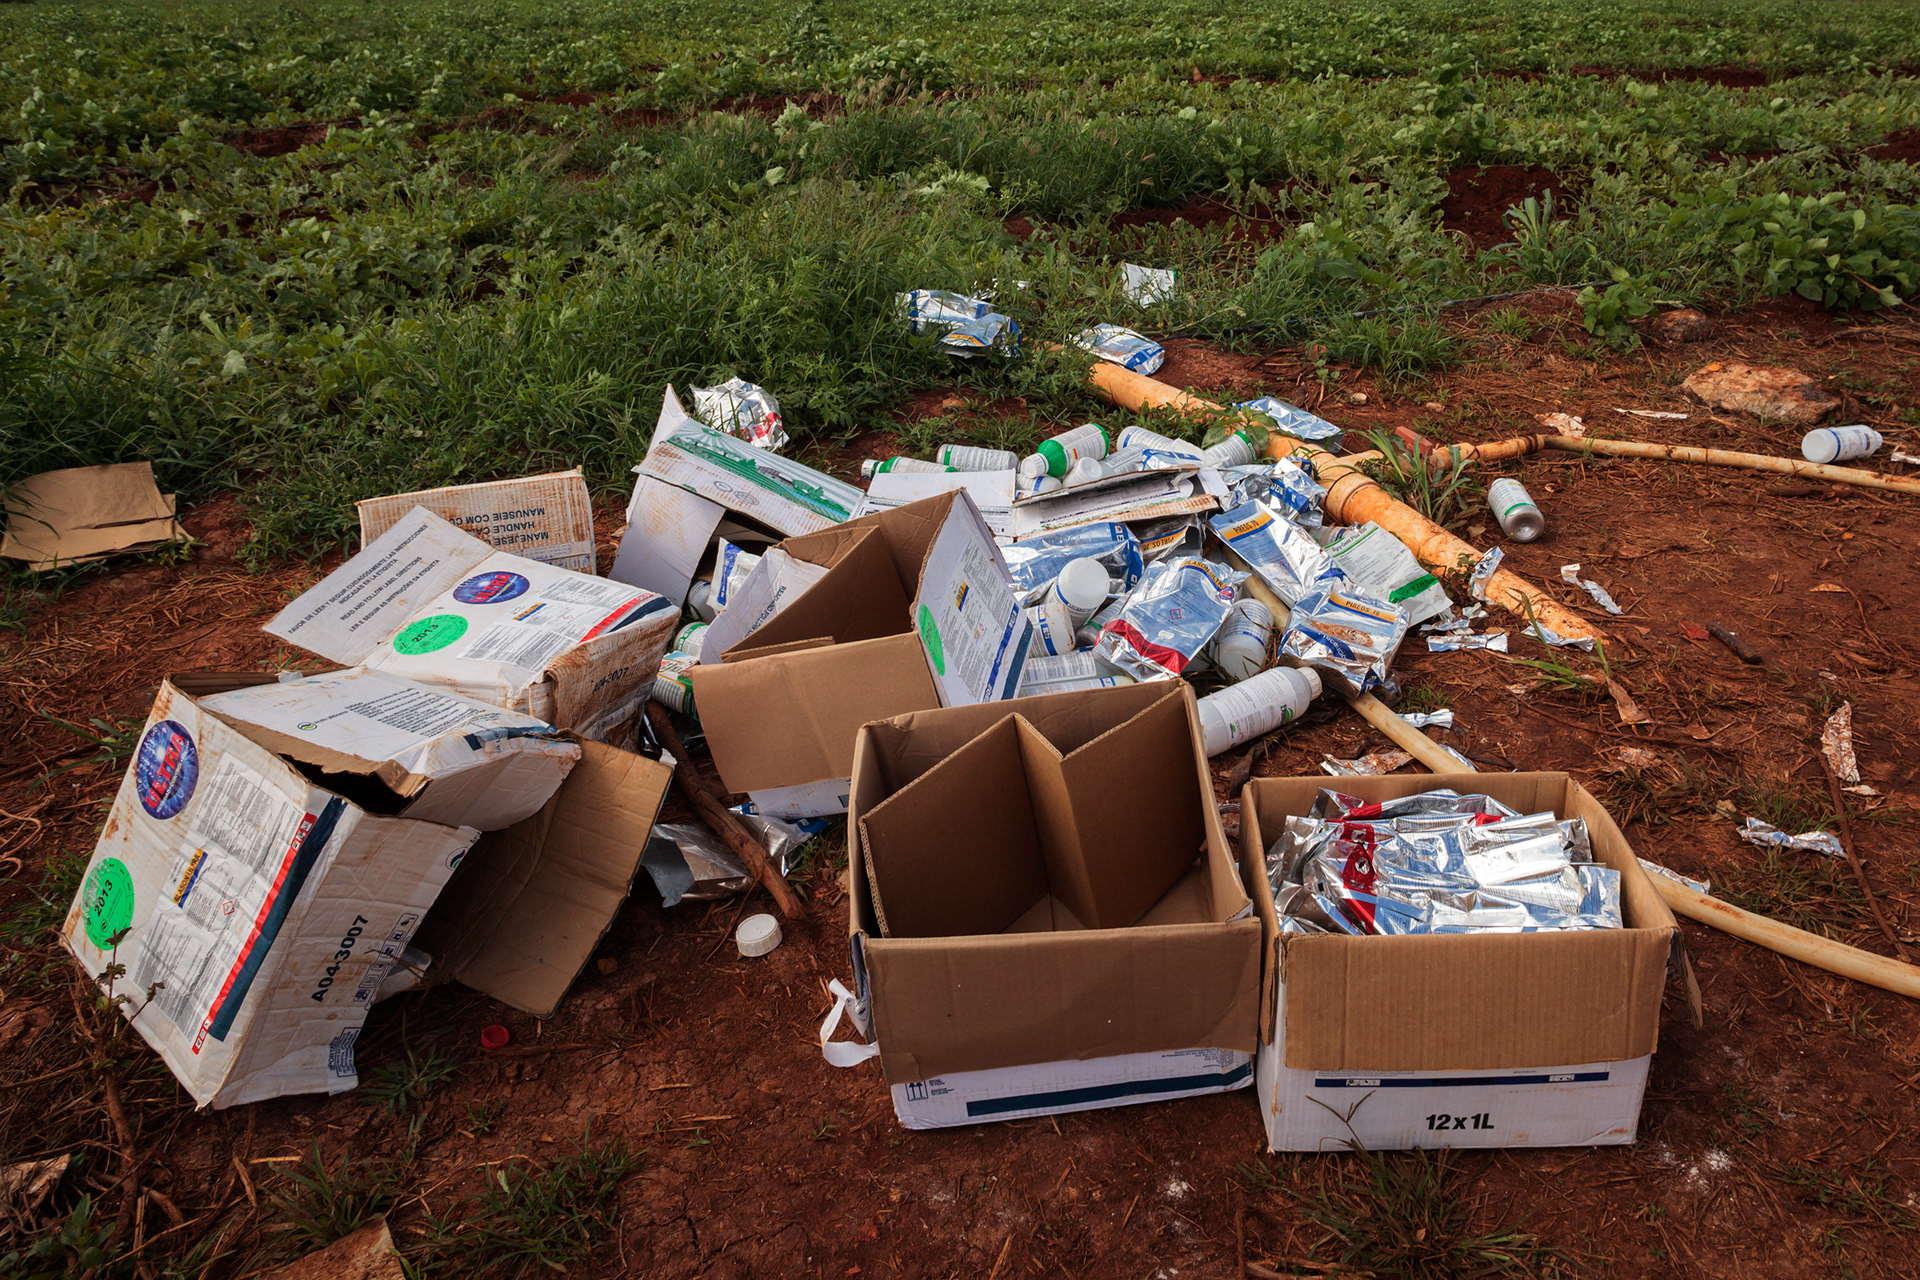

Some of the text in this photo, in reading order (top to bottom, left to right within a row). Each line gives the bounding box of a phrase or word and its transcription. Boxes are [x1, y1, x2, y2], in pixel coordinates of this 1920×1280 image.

[465, 512, 489, 525] COM
[492, 505, 545, 522] MANUSEIE
[492, 519, 534, 534] HANDLE
[494, 530, 548, 547] MANEJESE
[288, 618, 306, 634] FAVOR
[304, 613, 314, 622] DE
[312, 603, 326, 616] LEER
[328, 587, 347, 604] SEGUIR
[345, 557, 387, 590] CUIDADOSAMENTE
[384, 549, 396, 559] LAS
[394, 523, 428, 552] INSTRUCCIONES
[338, 557, 398, 605] INDICADAS EN LA ETIQUETA
[340, 555, 422, 621] READ AND FOLLOW LABEL DIRECTIONS
[472, 575, 511, 601] ULTRA
[348, 621, 361, 632] LER
[362, 605, 381, 621] SEGUIR
[379, 600, 387, 608] AS
[412, 574, 420, 582] DA
[418, 558, 440, 576] ETIQUETA
[773, 585, 786, 601] READ
[412, 625, 438, 642] 2013
[146, 732, 185, 809] ULTRA
[186, 853, 200, 875] ULTRA
[95, 880, 112, 916] 2013
[310, 914, 368, 1003] A04-3007
